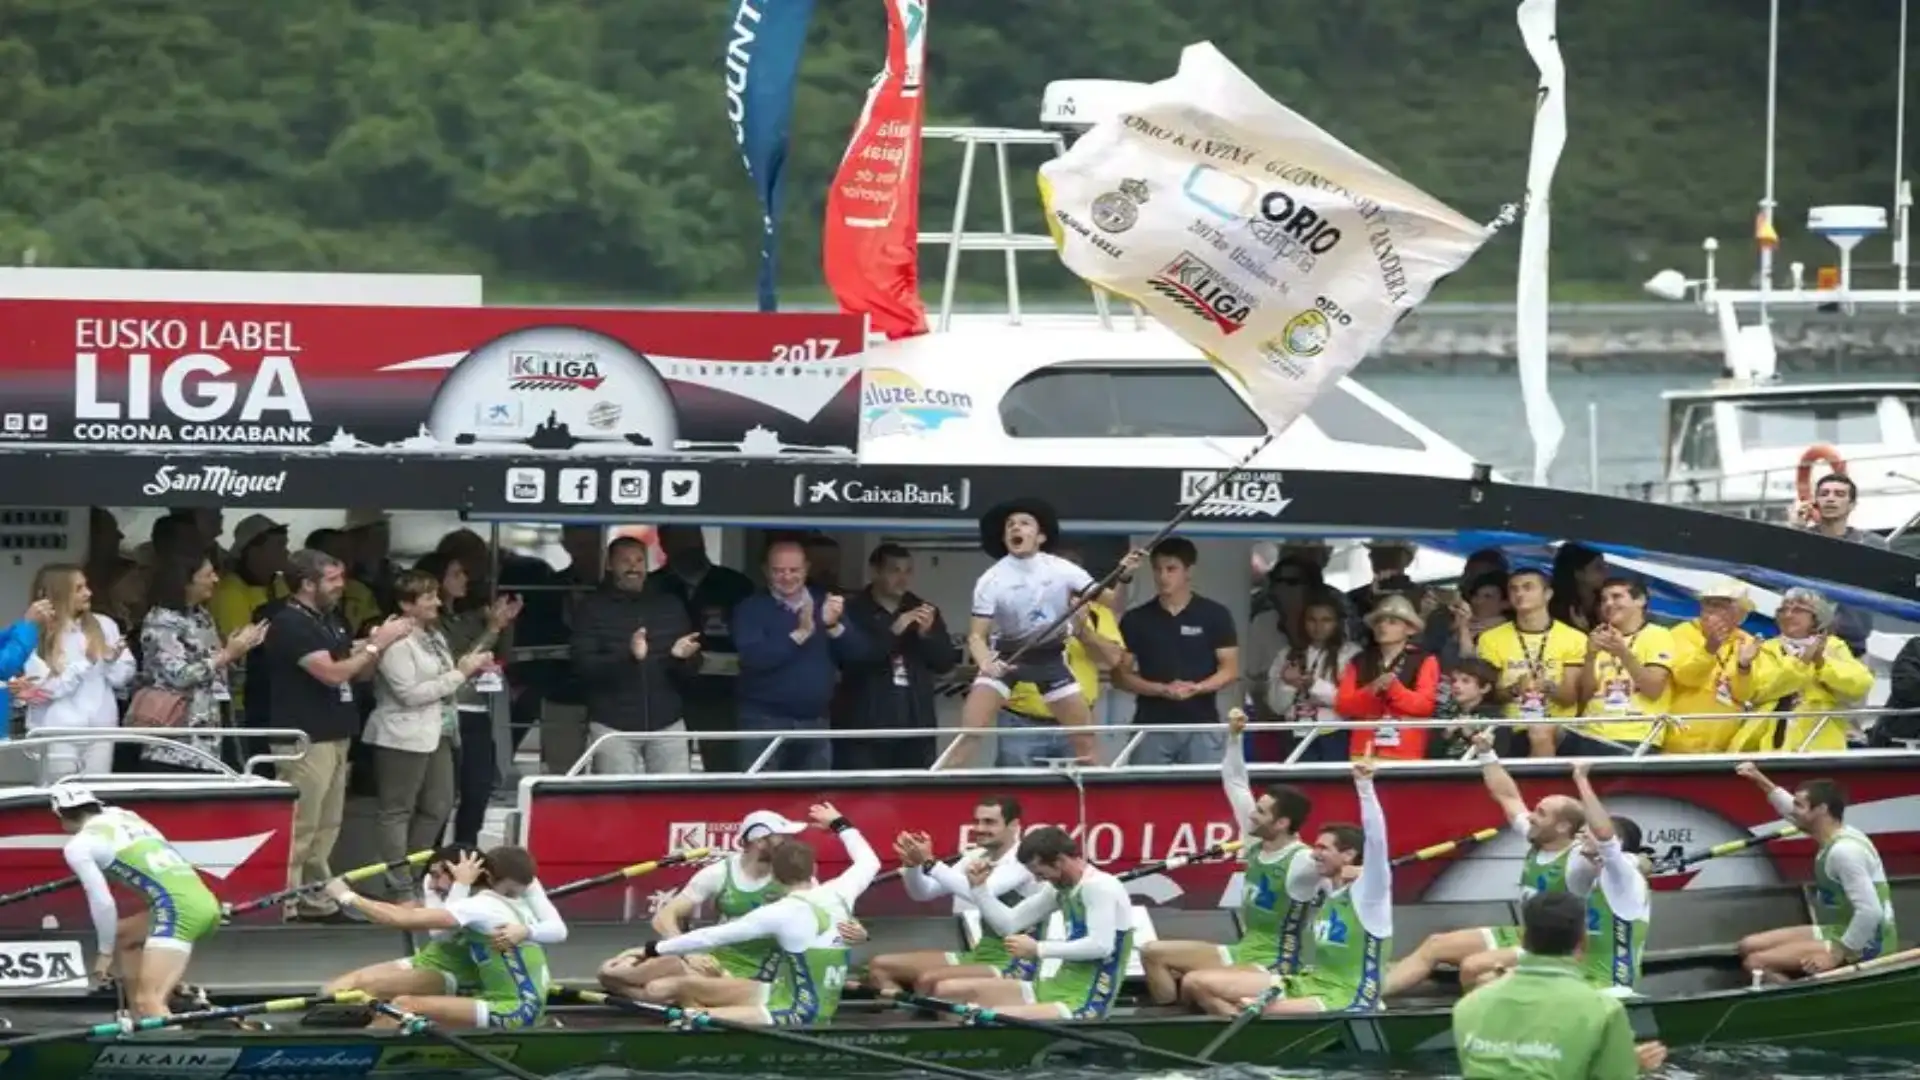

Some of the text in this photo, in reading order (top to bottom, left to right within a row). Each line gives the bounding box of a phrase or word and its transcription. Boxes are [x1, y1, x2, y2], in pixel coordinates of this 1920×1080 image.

[1261, 191, 1341, 255] ORIO
[1194, 276, 1250, 322] LIGA
[76, 319, 302, 351] EUSKO LABEL
[772, 338, 840, 363] 2017
[543, 359, 599, 377] LIGA
[74, 352, 313, 422] LIGA
[74, 424, 312, 443] CORONA CAIXABANK
[842, 480, 955, 505] CaixaBank
[1218, 482, 1283, 502] LIGA
[1140, 822, 1248, 865] LAB
[99, 1053, 208, 1066] ALKAIN
